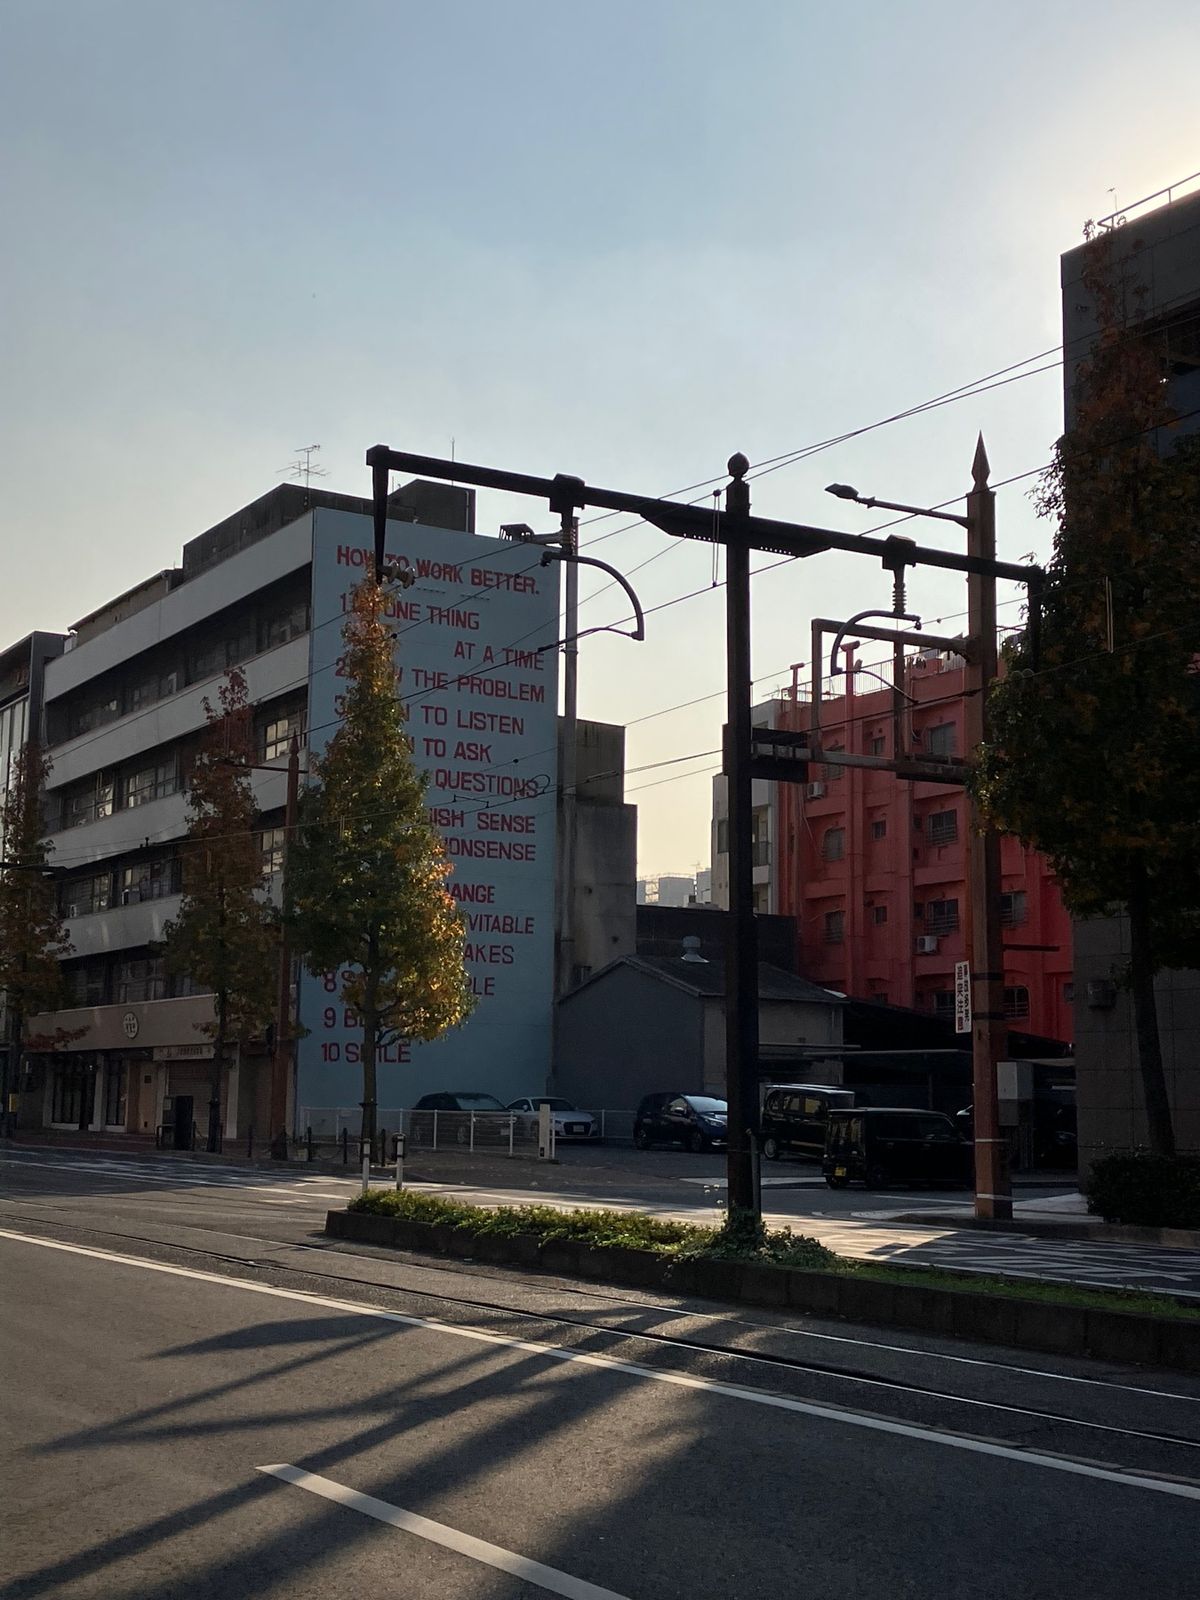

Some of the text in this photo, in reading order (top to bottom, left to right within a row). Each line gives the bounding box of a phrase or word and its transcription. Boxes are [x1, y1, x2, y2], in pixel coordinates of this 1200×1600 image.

[417, 557, 464, 584] WORK
[471, 568, 540, 596] BETTER.
[340, 593, 346, 612] 1
[427, 605, 480, 630] THING
[454, 641, 545, 671] AT A TIME
[335, 656, 346, 678] 2
[412, 669, 448, 690] THE
[457, 674, 545, 703] PROBLEM
[421, 705, 447, 726] TO
[457, 709, 524, 736] LISTEN
[422, 738, 446, 758] TO
[454, 742, 492, 763] ASK
[435, 769, 538, 798] QUESTIONS
[477, 811, 536, 834] SENSE
[449, 882, 495, 904] ANGE
[469, 914, 534, 934] VITABLE
[464, 944, 514, 964] AKES
[324, 971, 337, 993] 8
[324, 1007, 336, 1028] 9
[321, 1042, 340, 1062] 10
